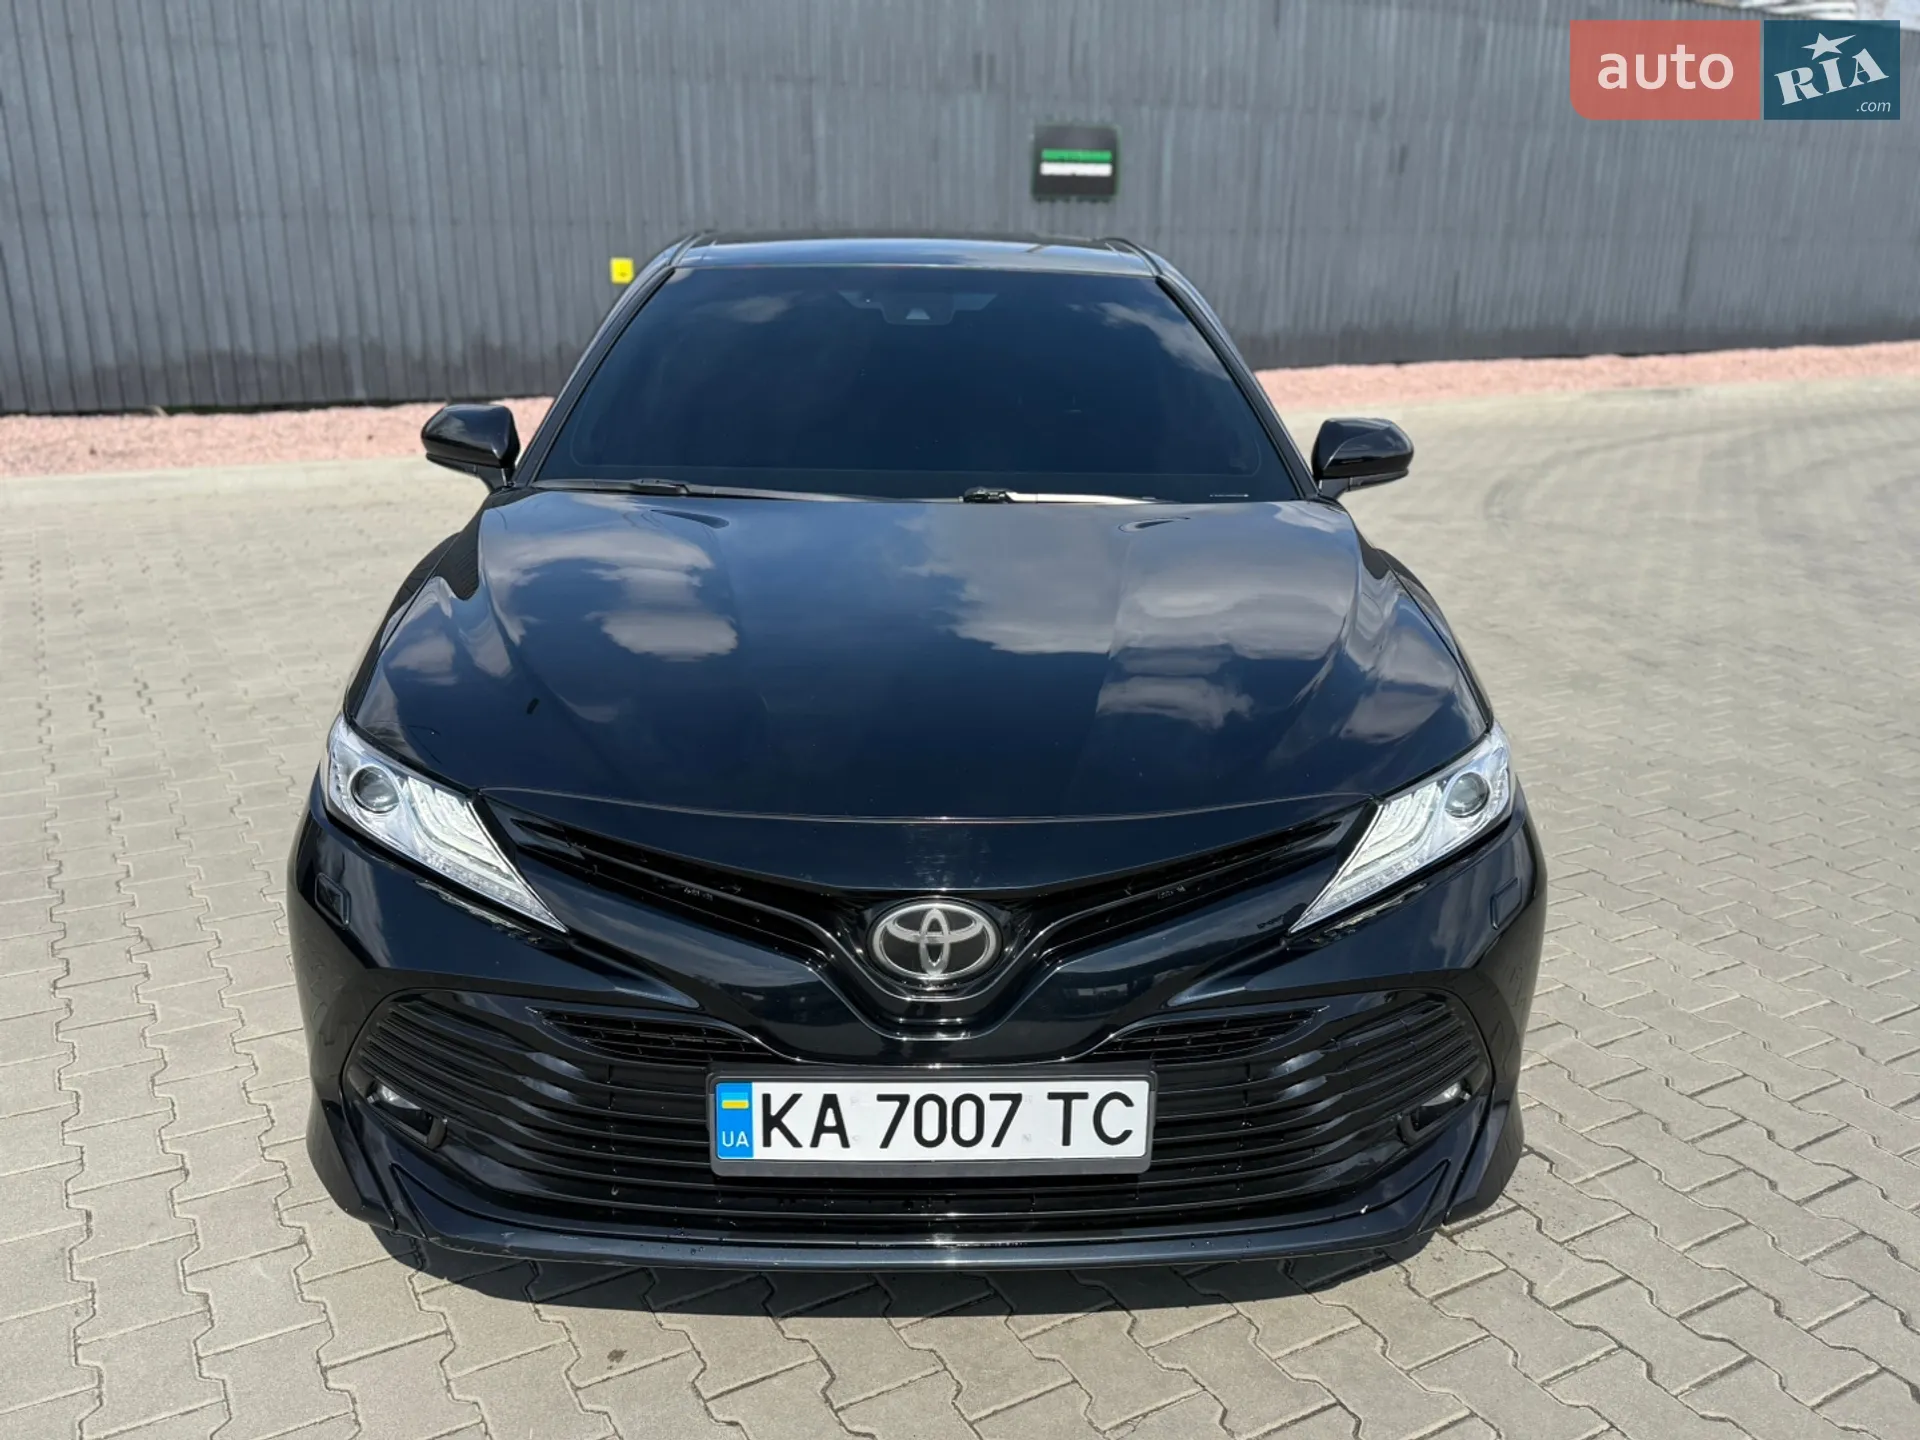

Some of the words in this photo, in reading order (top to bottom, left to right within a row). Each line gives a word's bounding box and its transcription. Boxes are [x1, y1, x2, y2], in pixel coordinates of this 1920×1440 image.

[722, 1130, 749, 1148] UA
[761, 1093, 850, 1149] KA
[876, 1093, 1023, 1149] 7007
[1047, 1091, 1135, 1147] TC
